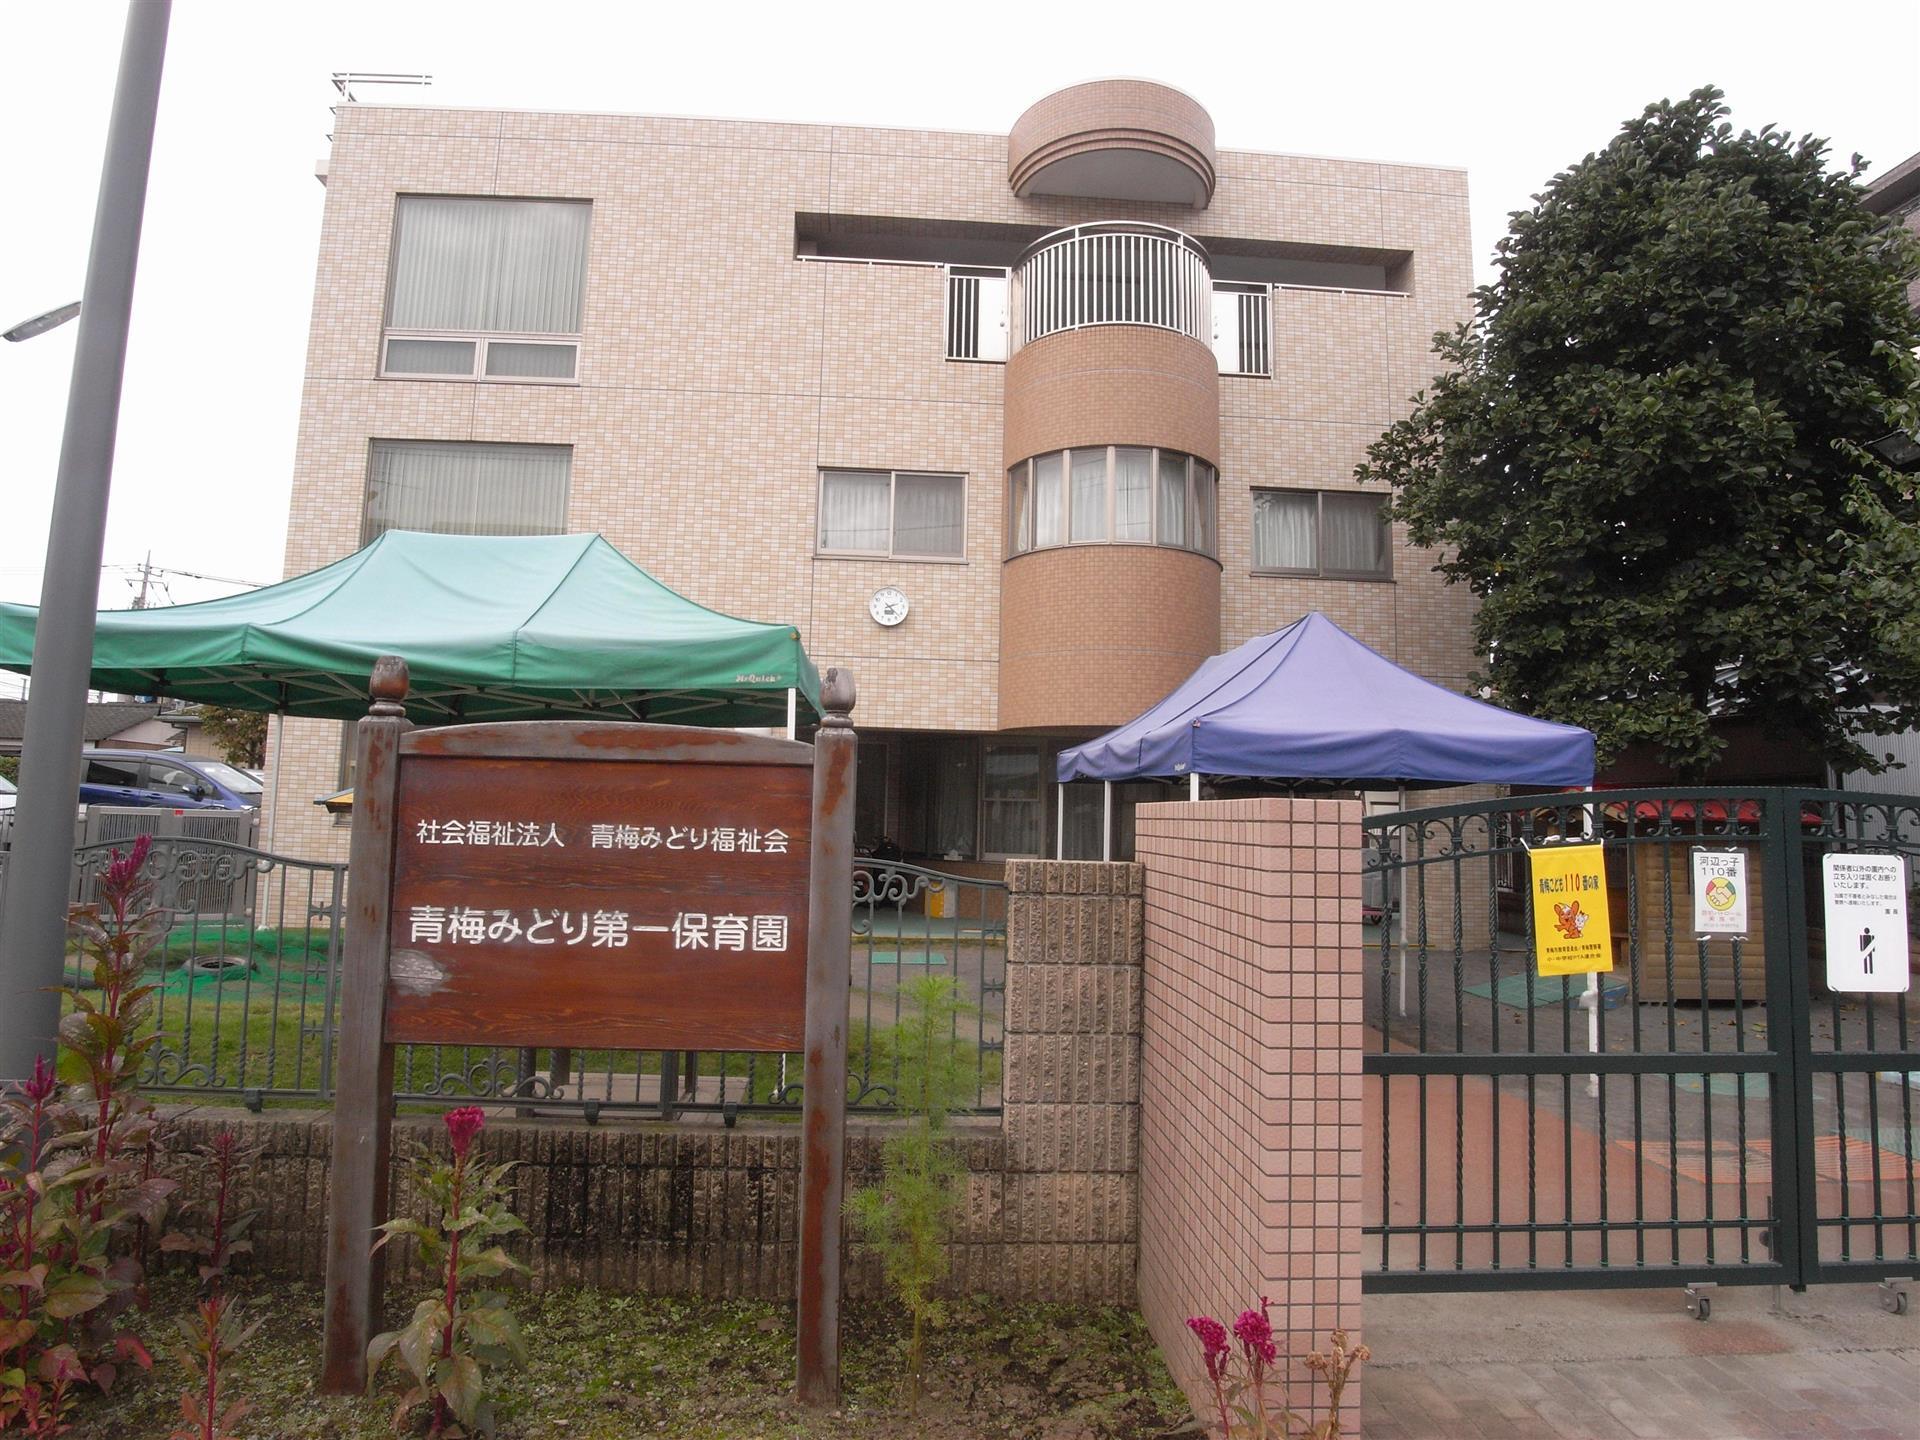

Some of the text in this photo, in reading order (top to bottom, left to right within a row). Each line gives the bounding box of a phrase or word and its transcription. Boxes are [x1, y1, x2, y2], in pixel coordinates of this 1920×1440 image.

[416, 819, 790, 854] 社会福祉法人 青梅みどり福祉会
[1699, 856, 1740, 867] 河辺っ子
[1702, 867, 1737, 877] 110番
[1833, 864, 1897, 873] 関係者以外の園内への
[1833, 873, 1897, 882] 立ち入りは固くお断り
[408, 905, 789, 952] 青梅みどり第一保育園
